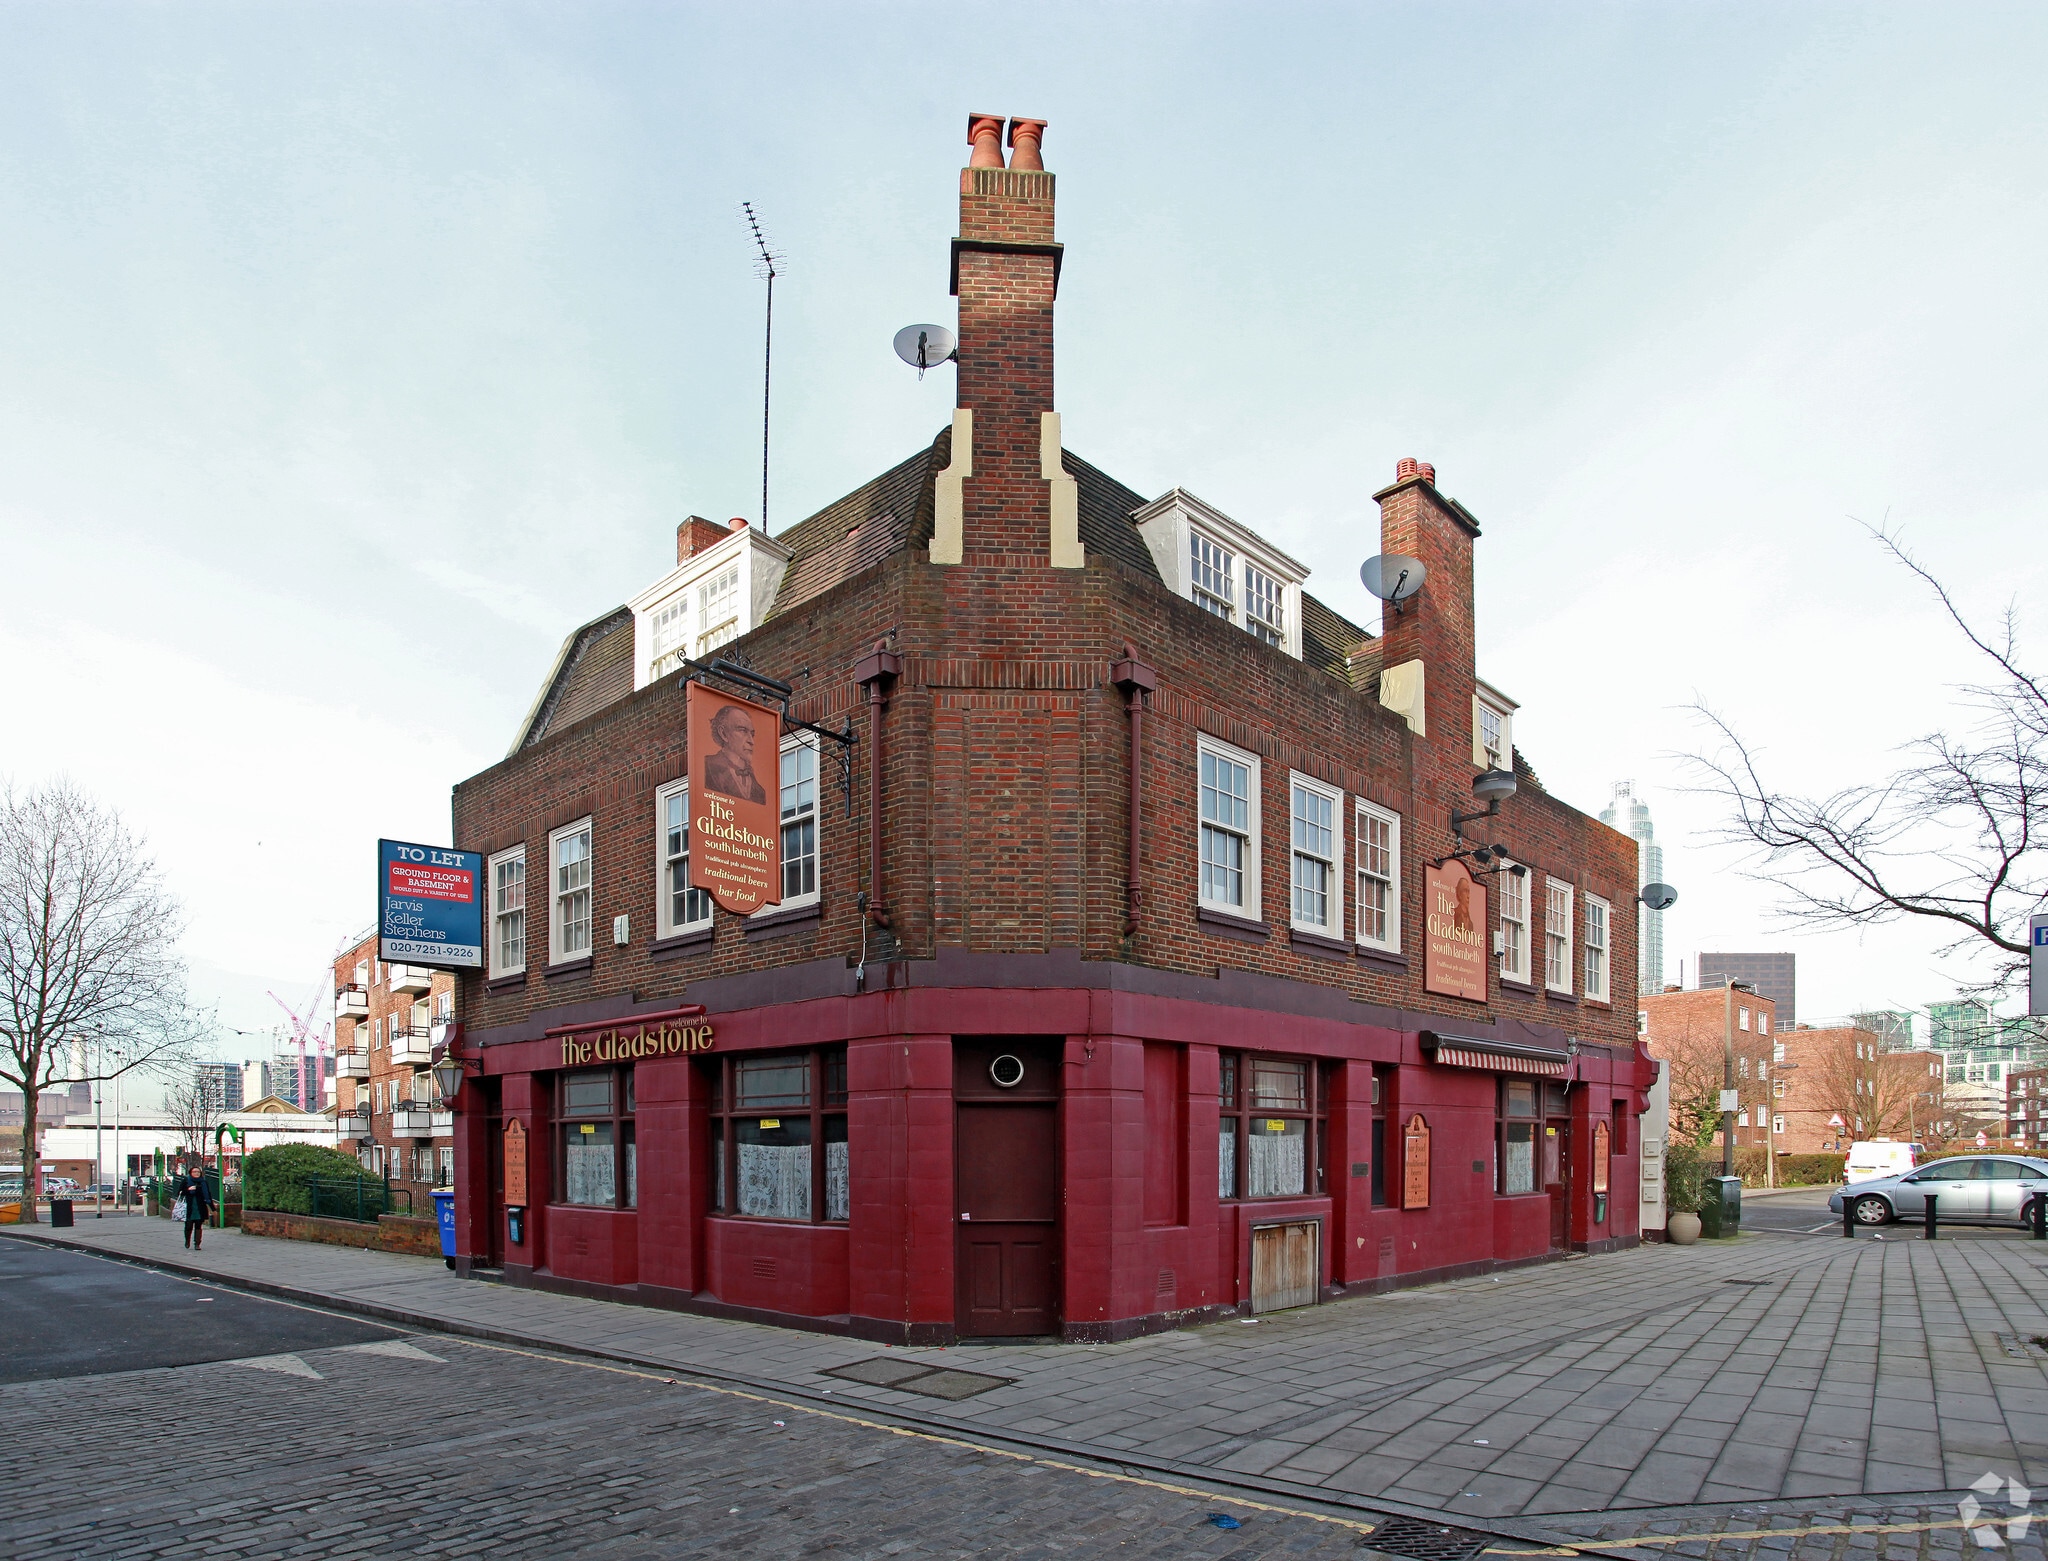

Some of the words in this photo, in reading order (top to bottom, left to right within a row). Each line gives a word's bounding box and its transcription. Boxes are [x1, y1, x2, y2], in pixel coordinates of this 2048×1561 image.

[703, 792, 728, 803] welcome
[710, 801, 735, 822] the
[696, 816, 775, 851] Gladstone
[398, 846, 425, 861] TO
[431, 851, 464, 867] LET
[704, 840, 731, 854] south
[732, 844, 768, 862] lambeth
[705, 854, 730, 865] traditional
[392, 867, 430, 879] GROUND
[433, 872, 461, 883] FLOOR
[463, 876, 470, 884] &
[704, 867, 747, 884] traditional
[748, 874, 768, 889] beers
[408, 878, 454, 891] BASEMENT
[718, 885, 734, 898] bar
[735, 889, 756, 902] food
[385, 897, 423, 911] Jarvis
[1437, 891, 1455, 916] the
[385, 911, 424, 926] Keller
[384, 922, 446, 939] Stephens
[1427, 913, 1484, 949] Gladstone
[390, 942, 474, 958] 020-7251-9226
[1432, 942, 1452, 957] south
[1453, 945, 1480, 963] lambeth
[669, 1017, 699, 1029] welcome
[699, 1015, 708, 1025] to
[561, 1035, 592, 1066] the
[594, 1022, 714, 1061] Gladstone
